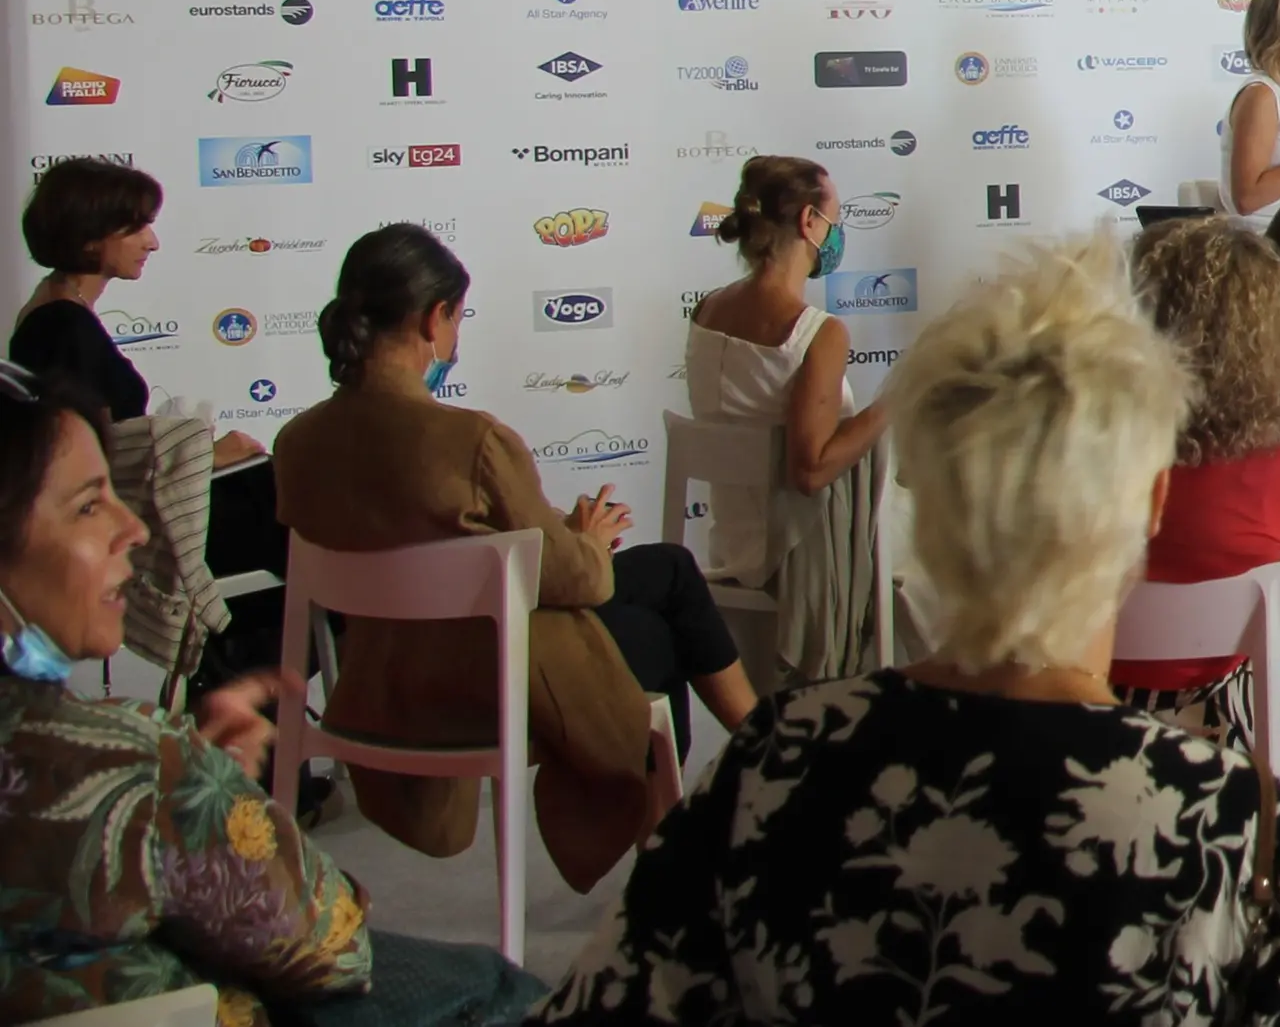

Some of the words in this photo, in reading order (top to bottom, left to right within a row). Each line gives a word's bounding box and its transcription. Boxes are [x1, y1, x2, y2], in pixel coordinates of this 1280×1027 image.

[189, 4, 274, 16] eurostands
[526, 9, 540, 19] All
[542, 8, 567, 19] Star
[569, 9, 608, 20] Agency
[32, 13, 135, 25] BOTTEGA
[551, 60, 590, 74] IBSA
[1102, 56, 1168, 67] WACEBO
[392, 58, 432, 96] H
[677, 67, 724, 79] TV2000
[62, 81, 106, 90] RADIO
[222, 73, 282, 90] Fiorucci
[725, 79, 759, 91] inBlu
[62, 88, 106, 97] ITALIA
[535, 92, 562, 101] Caring
[564, 91, 607, 100] Innovation
[973, 125, 1029, 145] aeffe
[1090, 134, 1101, 143] All
[1103, 134, 1123, 143] Star
[1125, 134, 1158, 145] Agency
[816, 138, 885, 150] eurostands
[373, 149, 405, 166] sky
[413, 148, 455, 166] tg24
[534, 144, 629, 166] Bompani
[677, 146, 759, 158] BOTTEGA
[1109, 186, 1141, 199] IBSA
[987, 184, 1020, 220] H
[843, 204, 892, 217] Fiorucci
[550, 296, 600, 321] Yoga
[116, 321, 179, 335] COMO
[219, 409, 234, 420] All
[236, 408, 263, 419] Star
[595, 438, 648, 452] COMO
